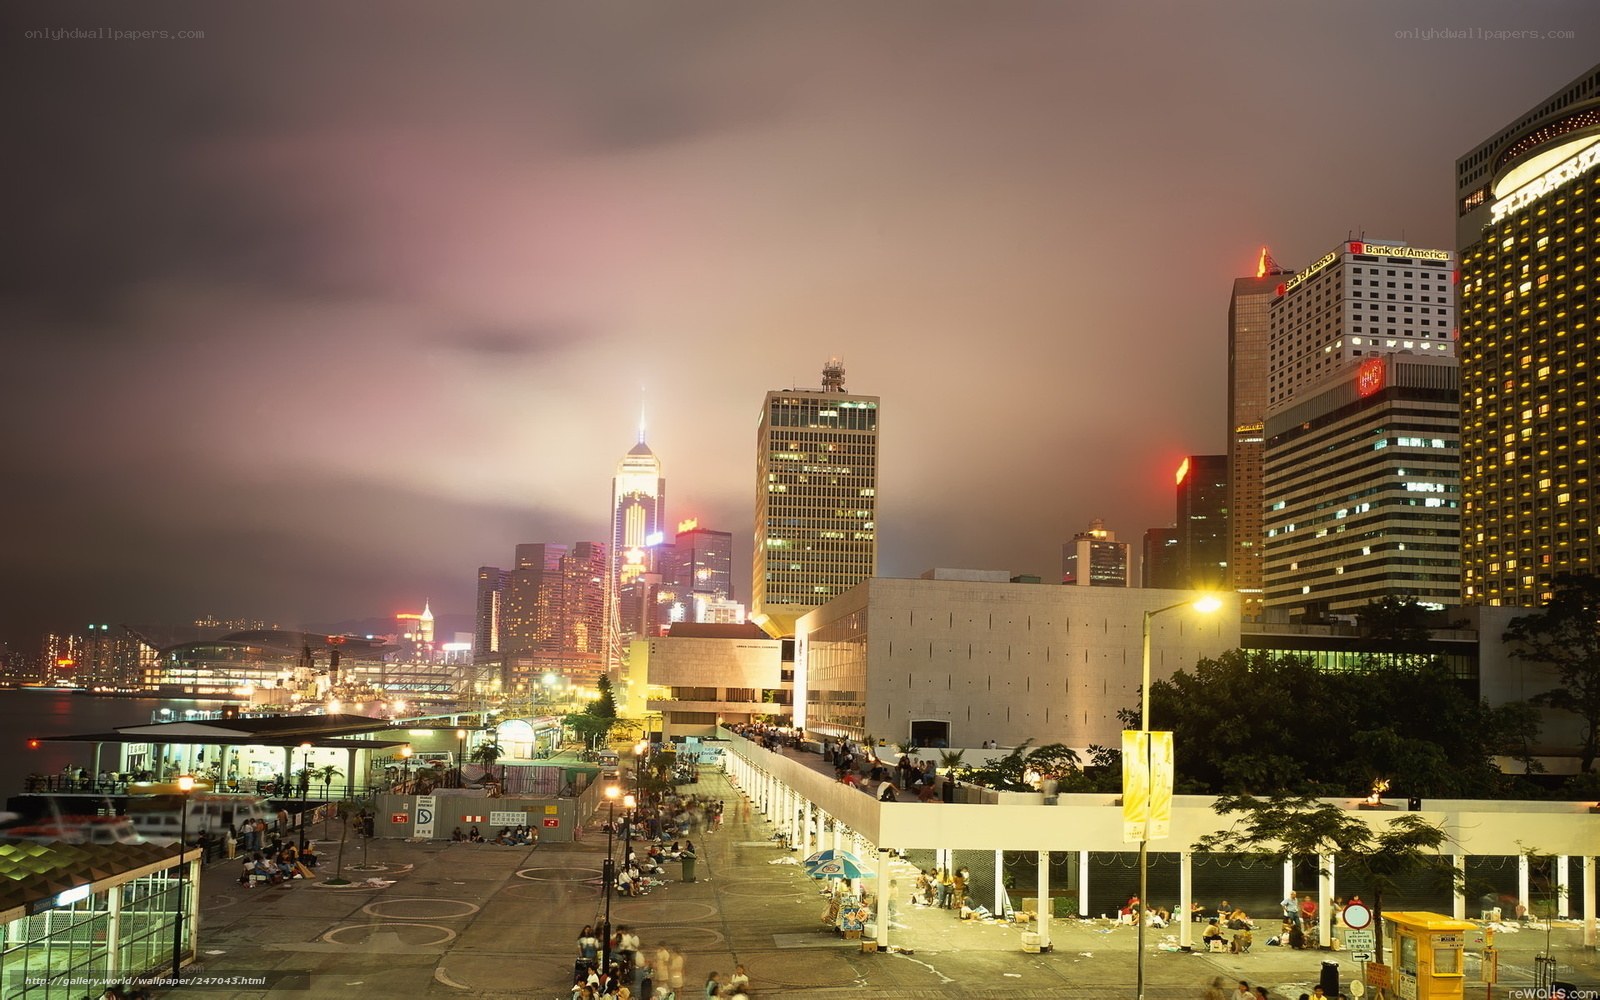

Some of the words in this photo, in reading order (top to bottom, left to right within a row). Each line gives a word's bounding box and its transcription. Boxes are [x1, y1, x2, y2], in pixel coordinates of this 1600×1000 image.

[1365, 244, 1391, 255] Bank
[1393, 246, 1405, 256] of
[1407, 248, 1449, 260] America
[1285, 275, 1300, 290] Bank
[1308, 253, 1335, 276] America
